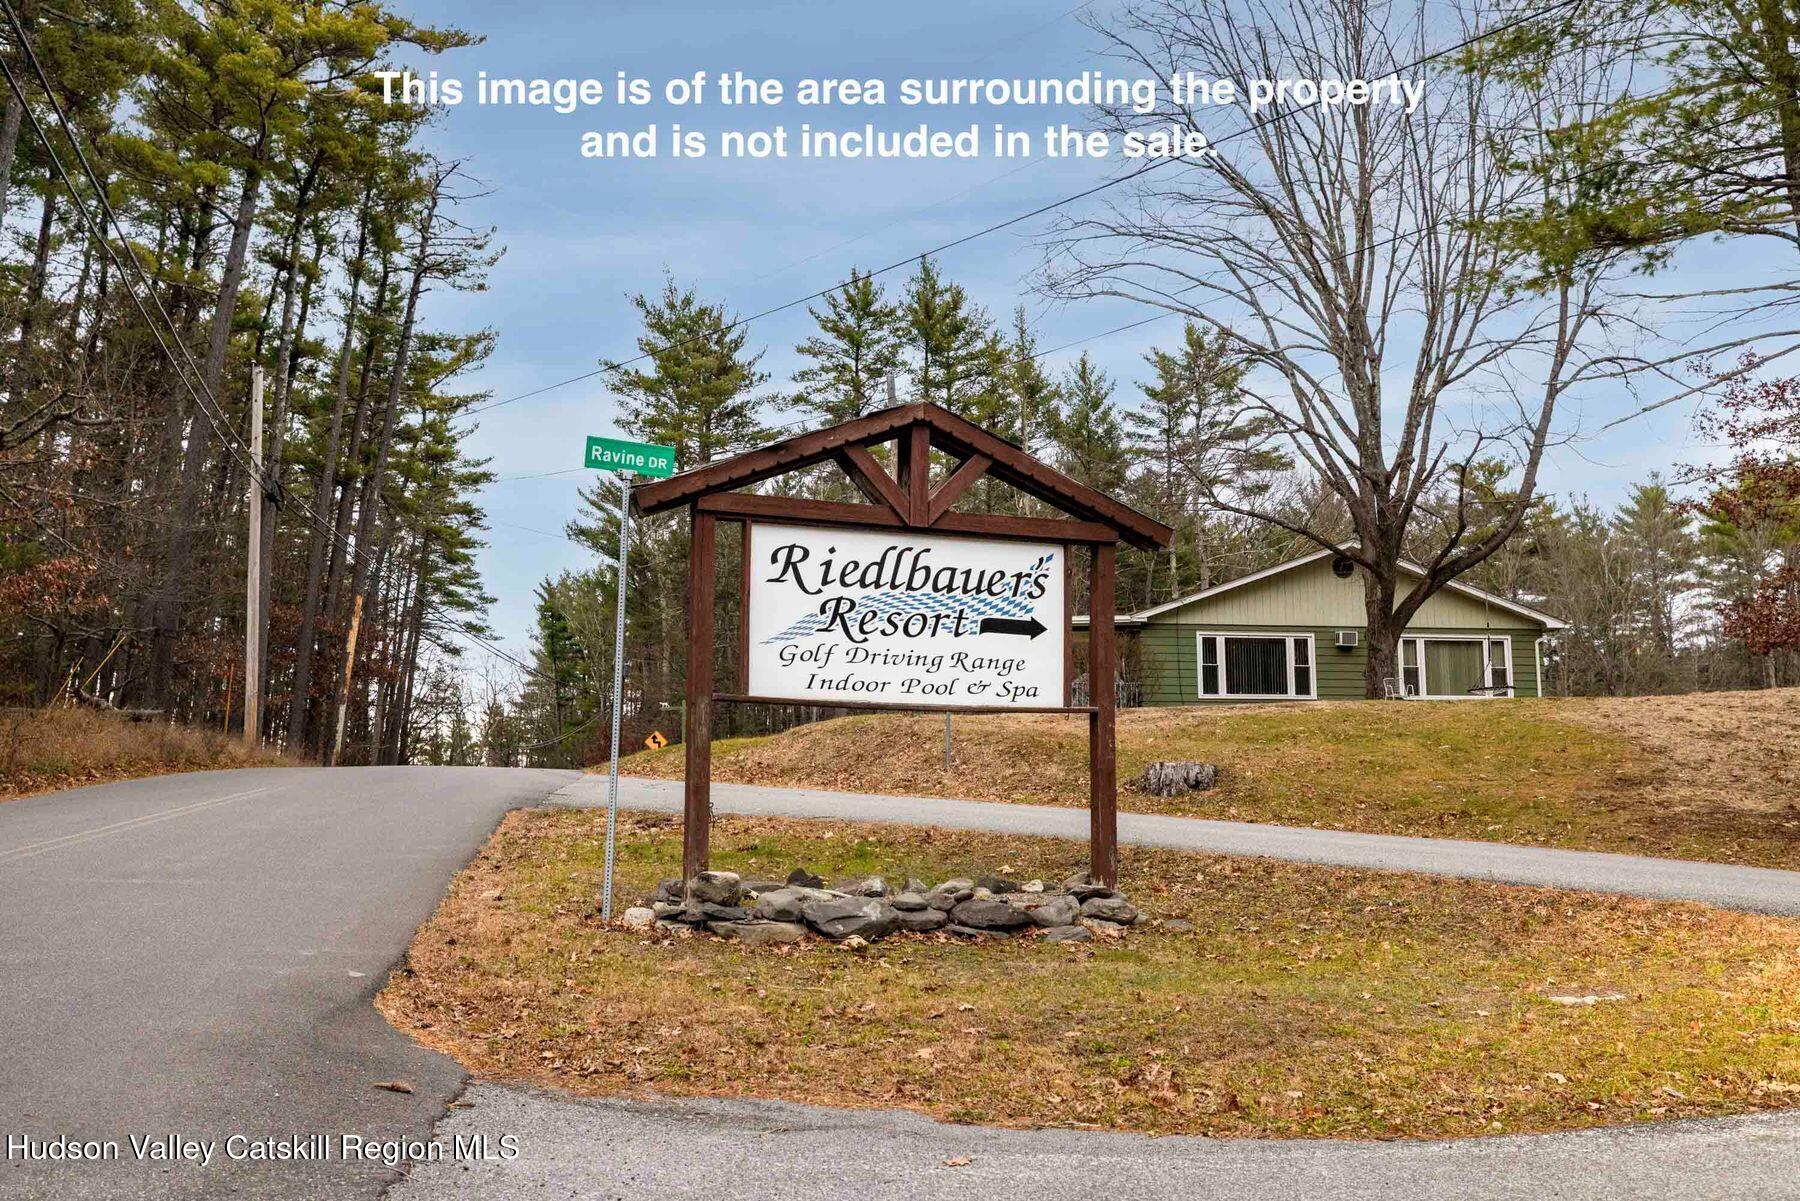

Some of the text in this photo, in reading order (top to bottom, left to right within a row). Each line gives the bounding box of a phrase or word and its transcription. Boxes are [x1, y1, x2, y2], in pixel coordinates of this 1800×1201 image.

[591, 445, 668, 470] Ravine DR
[765, 543, 1050, 600] Riedlbauer's
[815, 595, 970, 644] Resort
[779, 643, 1027, 677] Golf Driving Range
[804, 673, 1040, 702] Indoor Pool & Spa
